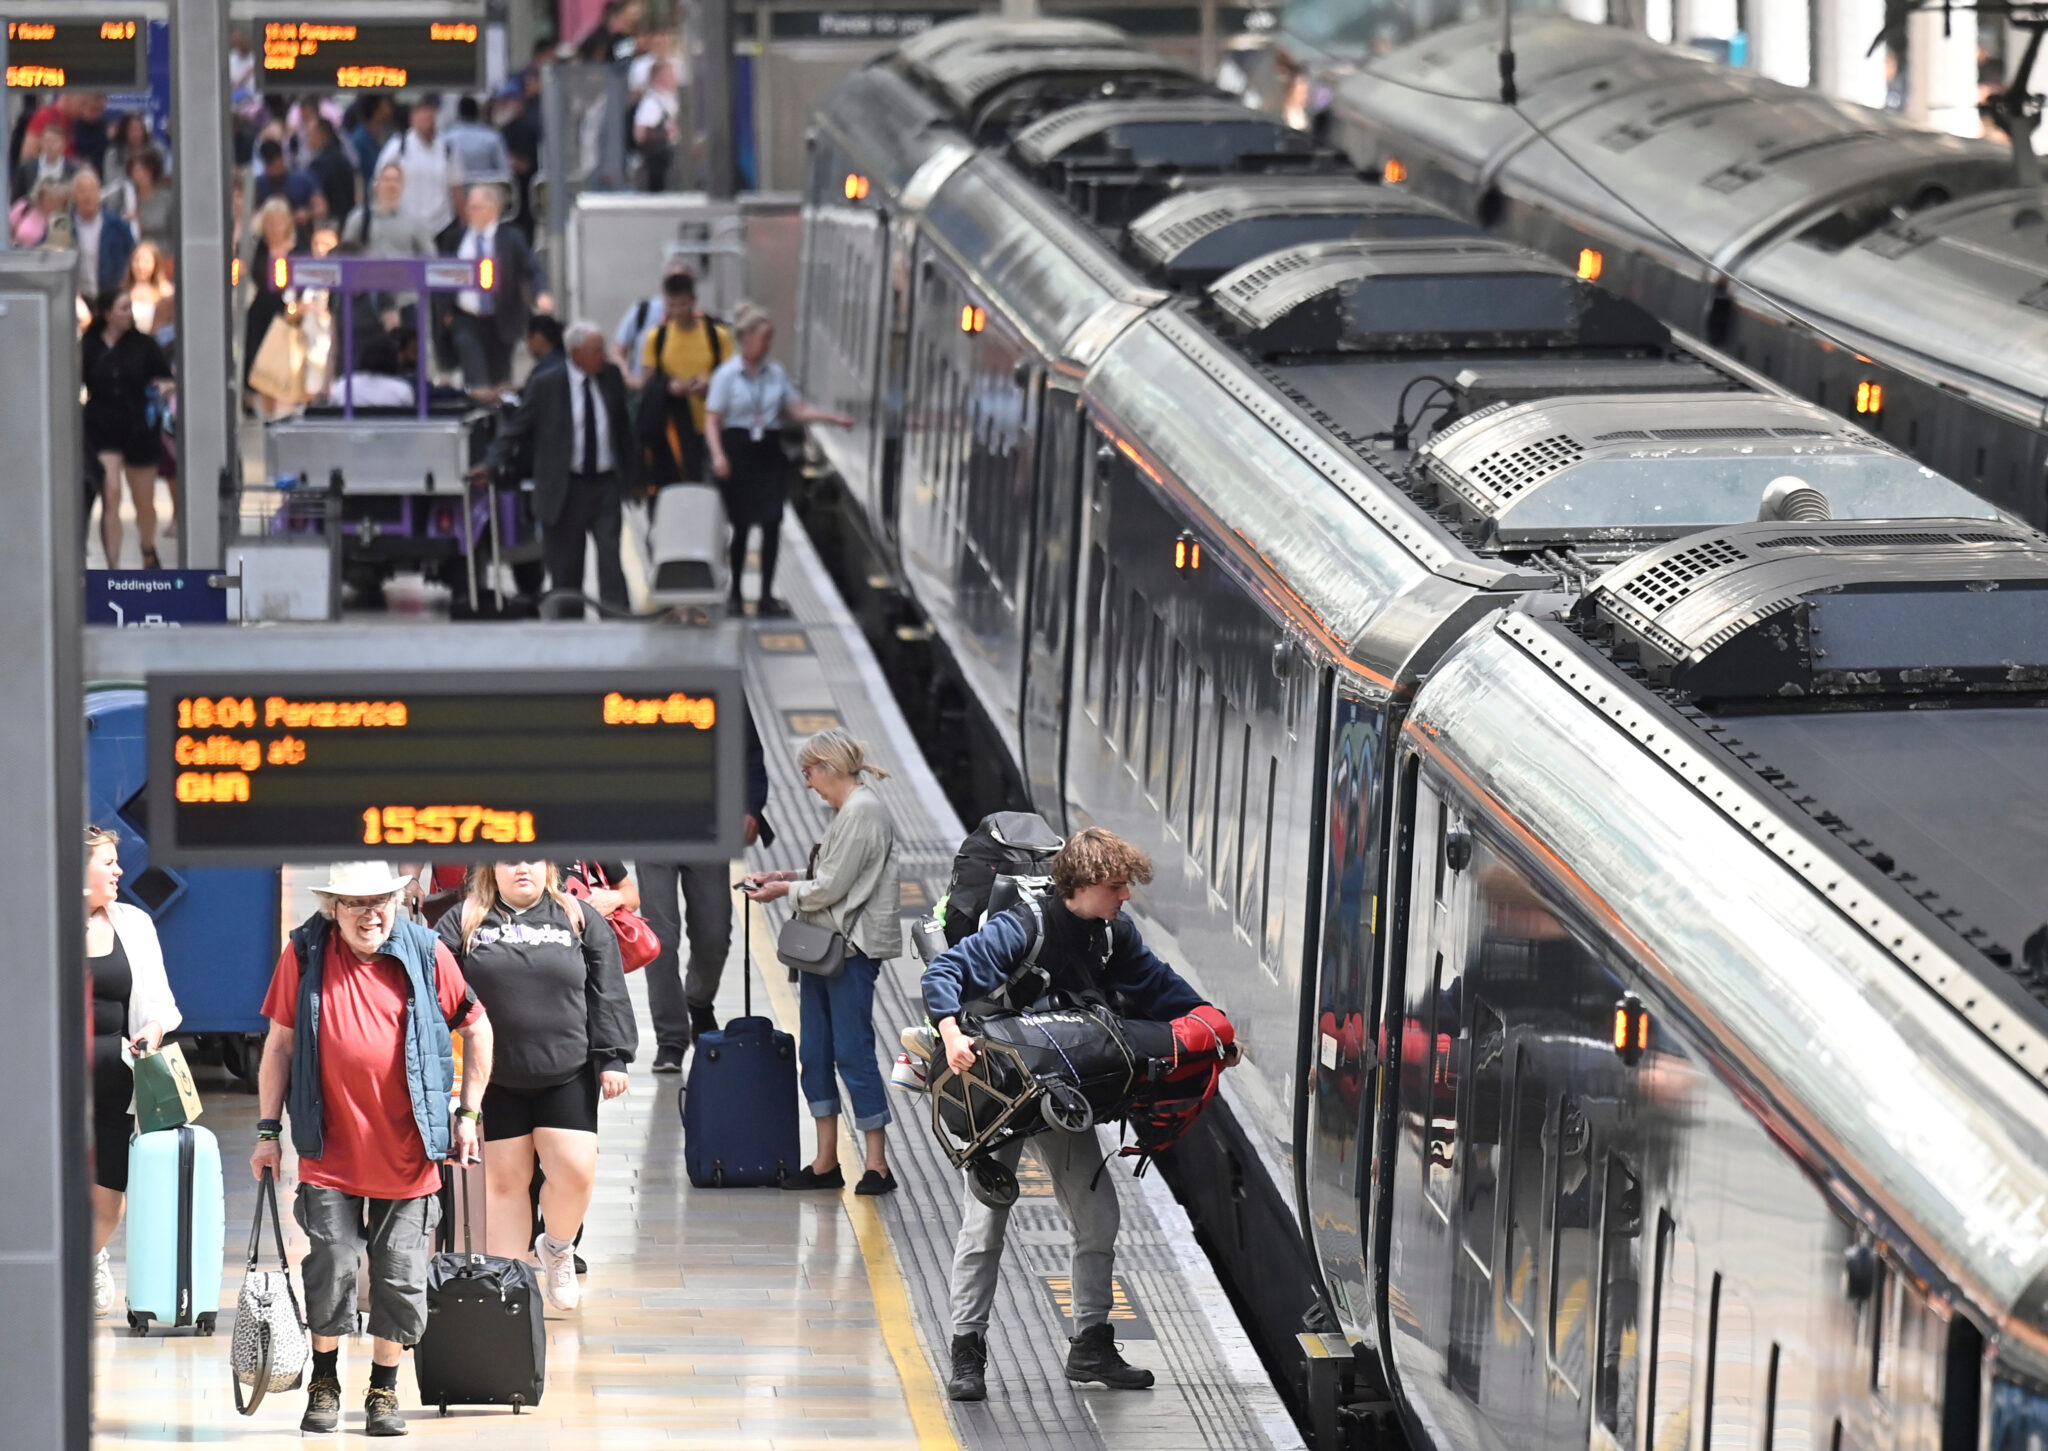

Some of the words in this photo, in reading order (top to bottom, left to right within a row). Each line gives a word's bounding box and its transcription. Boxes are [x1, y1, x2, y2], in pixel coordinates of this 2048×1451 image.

[107, 578, 172, 593] Paddington
[177, 696, 257, 729] 16:04
[264, 696, 408, 728] Penzance
[602, 691, 716, 730] Boarding
[174, 734, 262, 772] Calling
